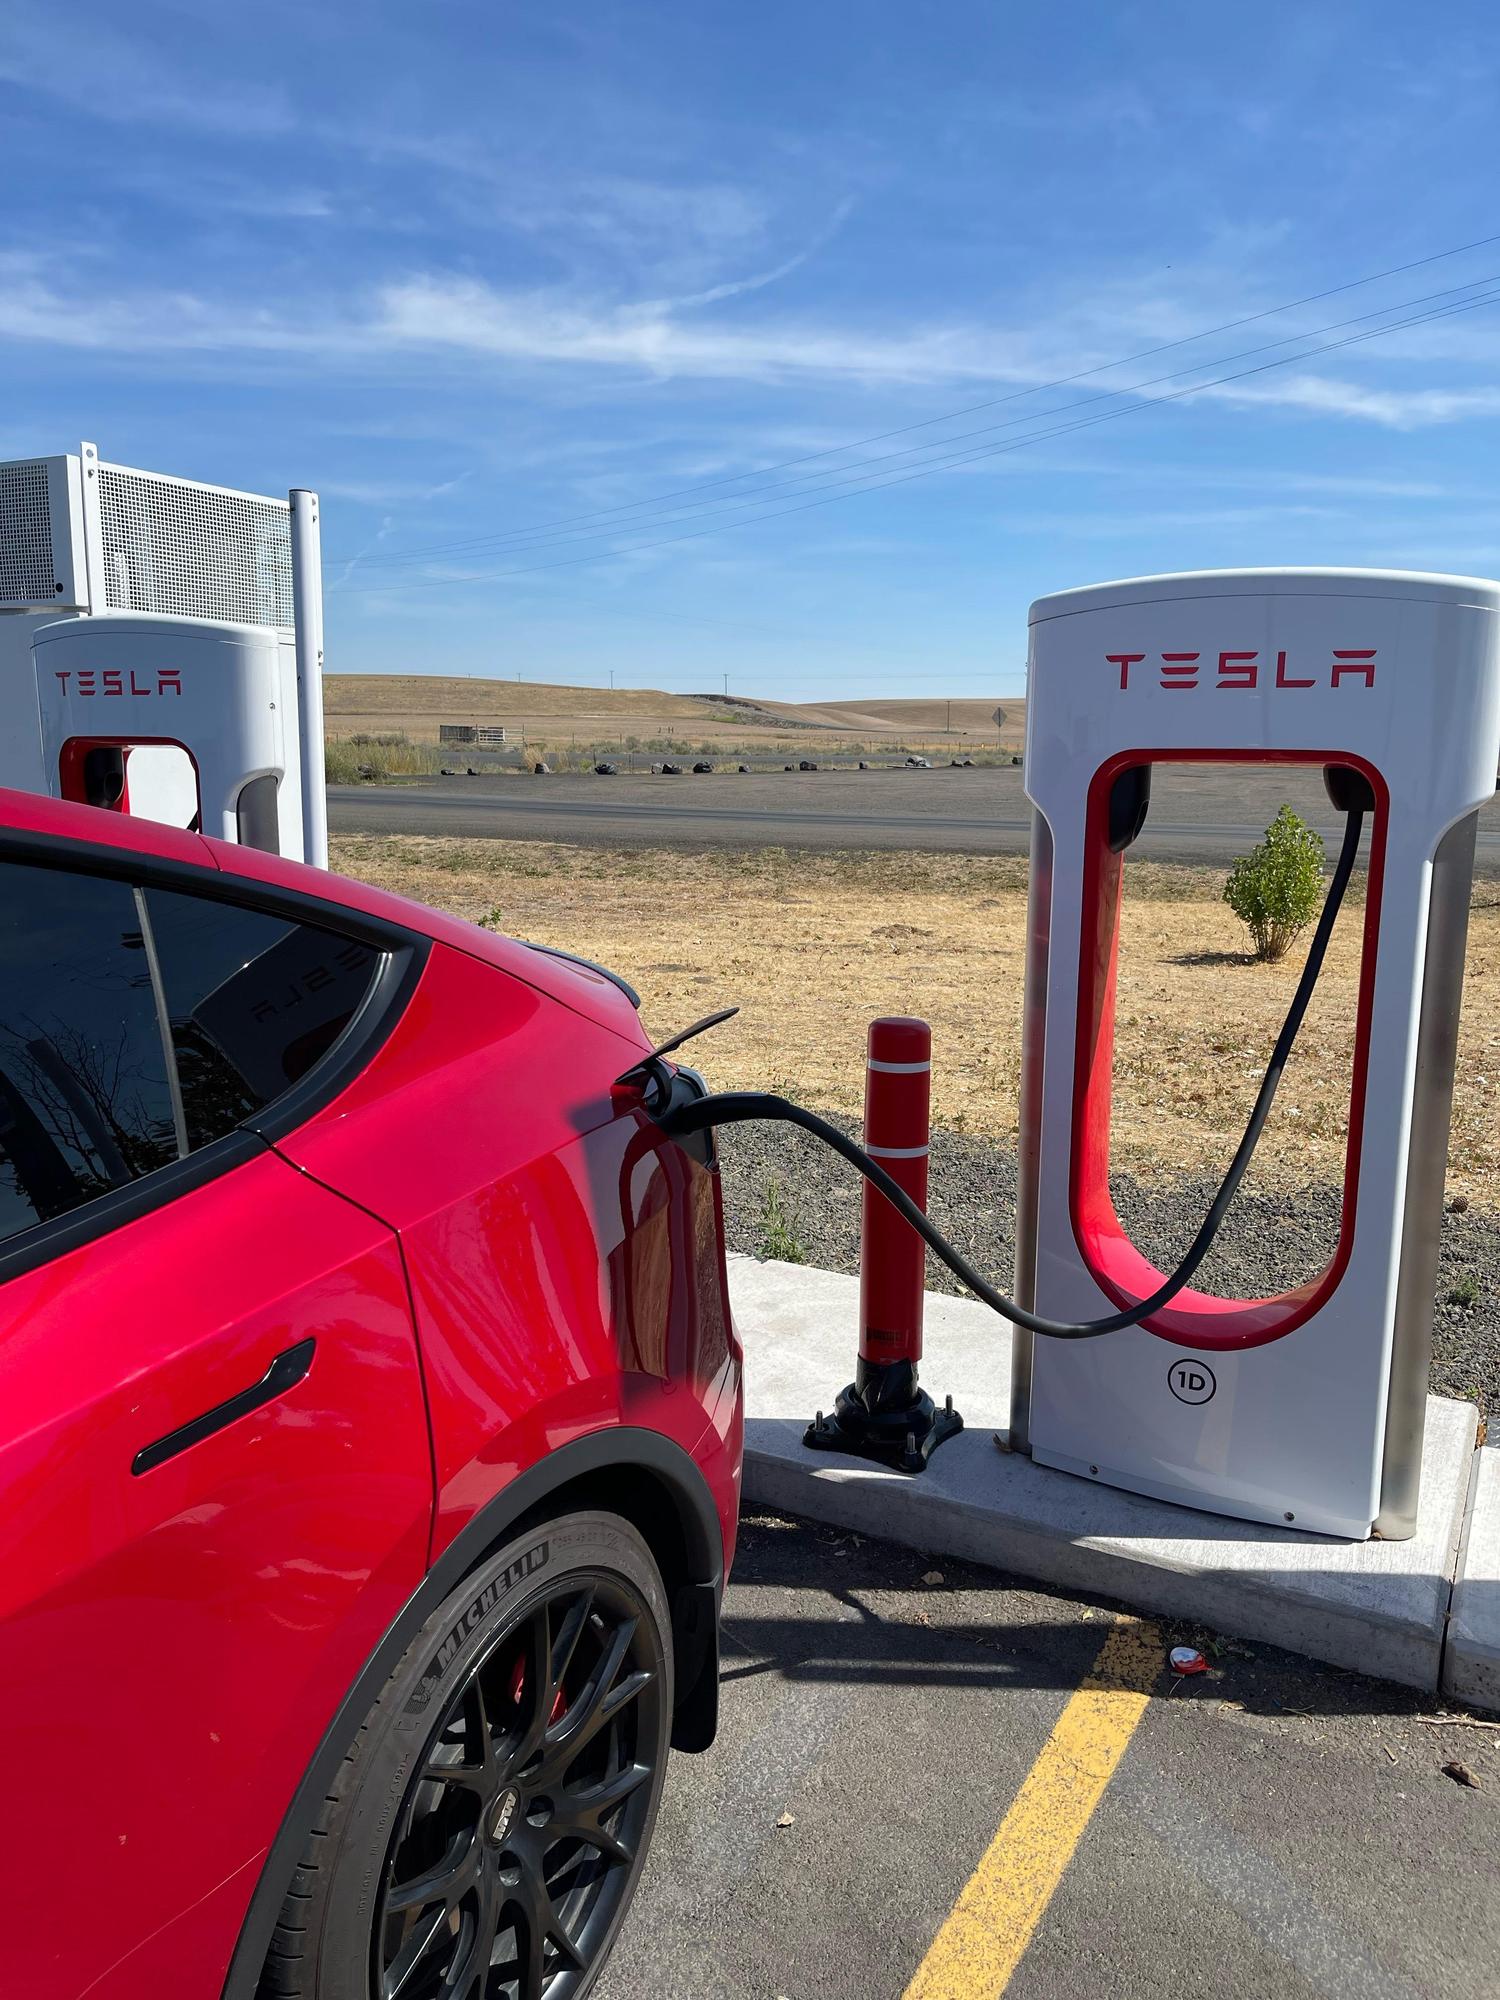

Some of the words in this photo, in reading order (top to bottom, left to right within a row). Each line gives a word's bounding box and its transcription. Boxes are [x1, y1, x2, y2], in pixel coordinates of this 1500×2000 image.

[55, 670, 182, 696] TESLA
[1106, 649, 1377, 690] TESLA
[1178, 1370, 1206, 1391] 1D
[436, 1542, 546, 1670] MICHELIN
